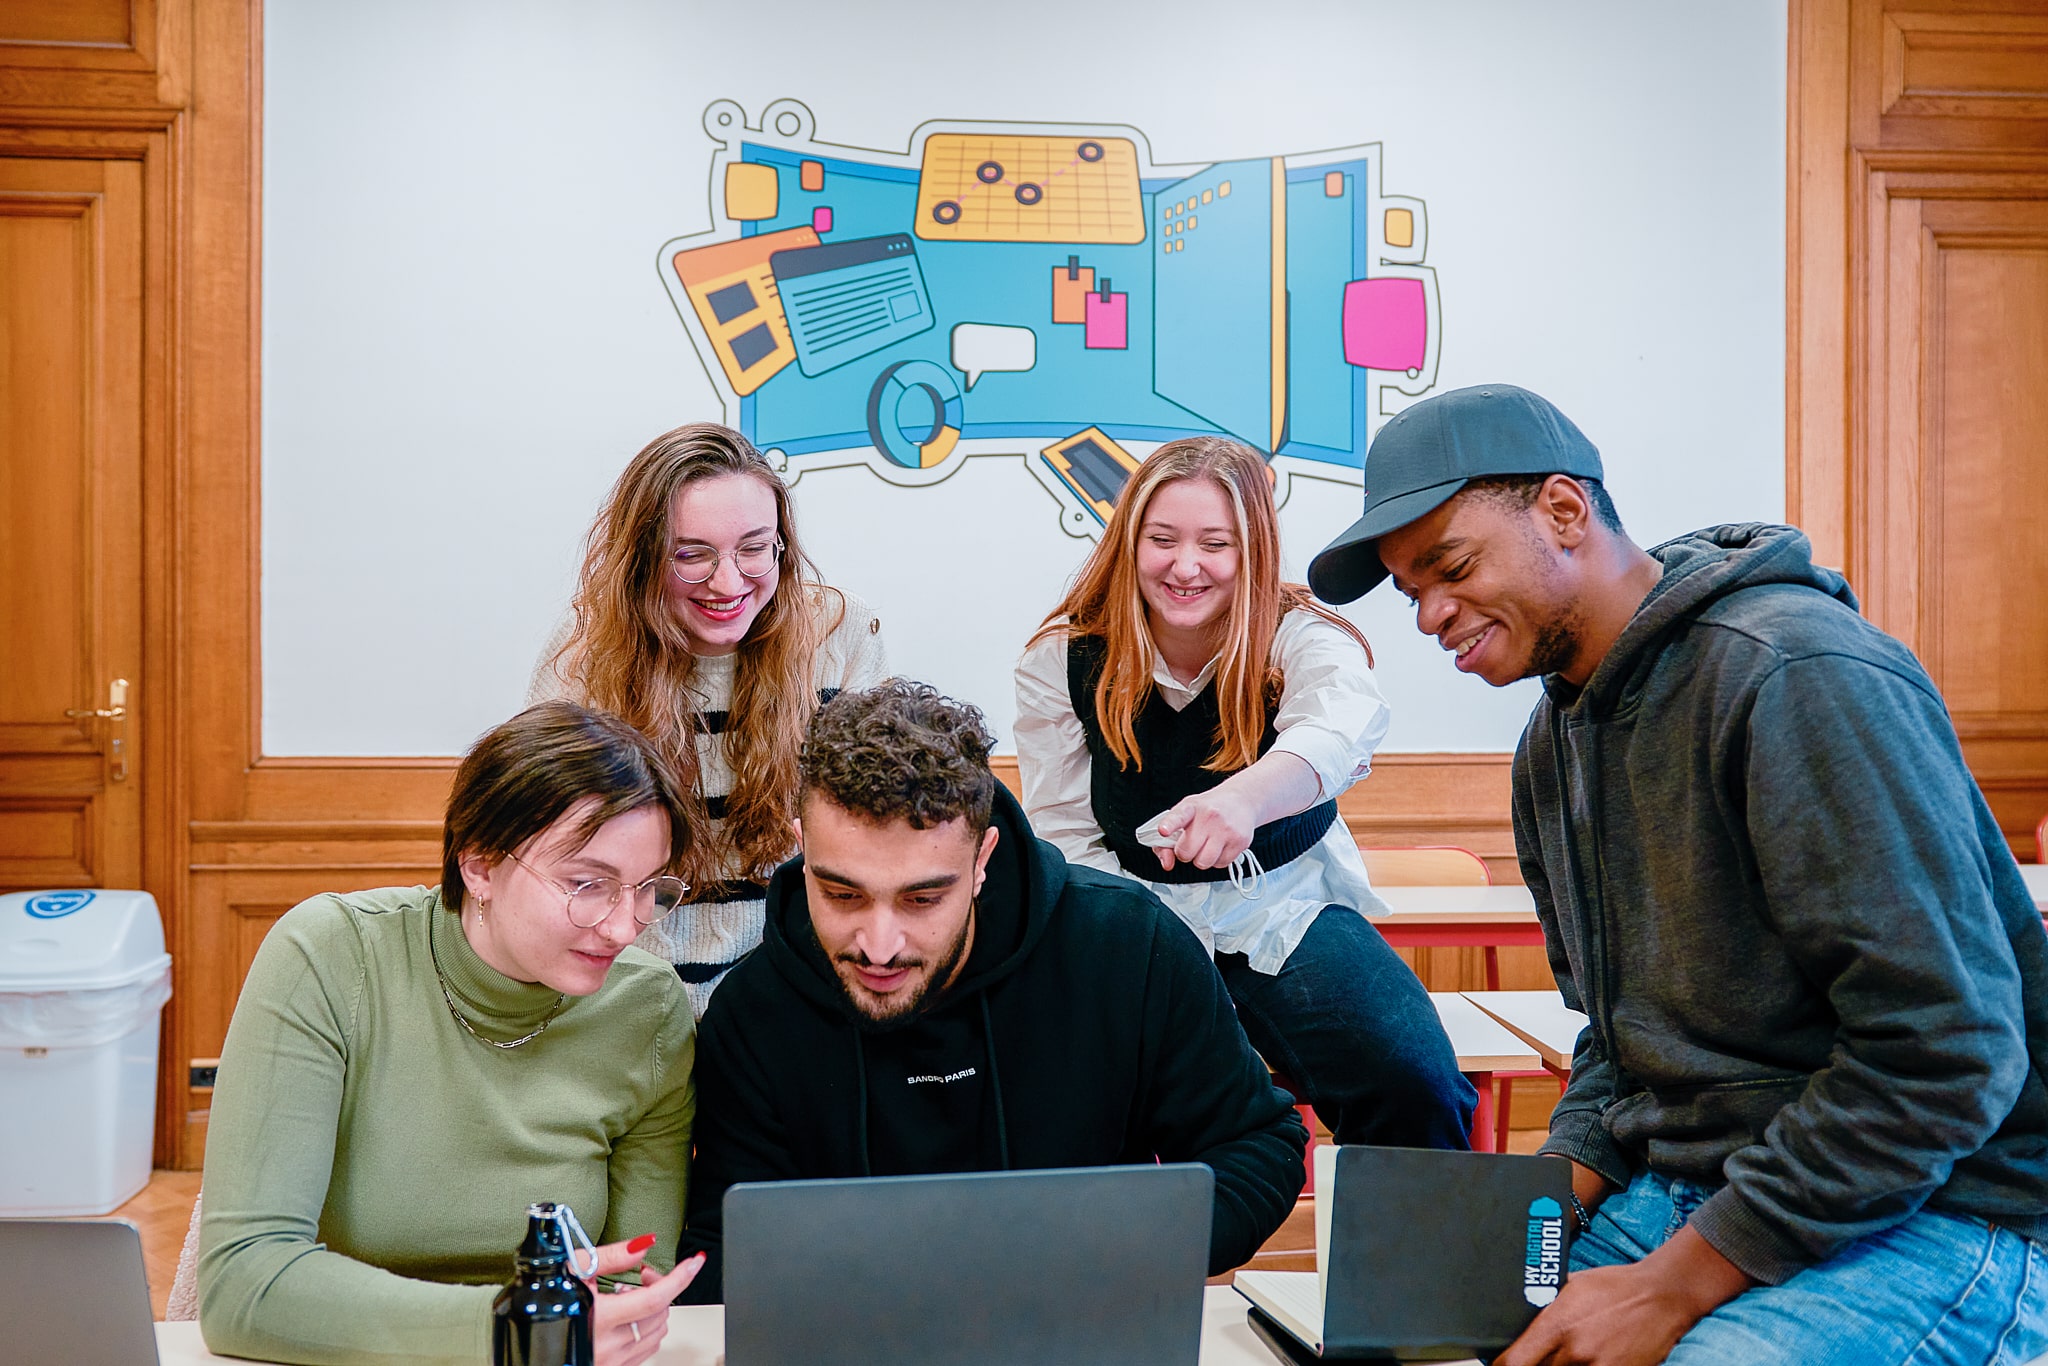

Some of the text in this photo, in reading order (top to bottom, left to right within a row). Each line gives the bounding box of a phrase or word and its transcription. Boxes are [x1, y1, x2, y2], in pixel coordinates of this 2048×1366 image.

[945, 1067, 976, 1083] PARIS
[1540, 1218, 1562, 1285] SCHOOL
[1524, 1265, 1541, 1285] MY
